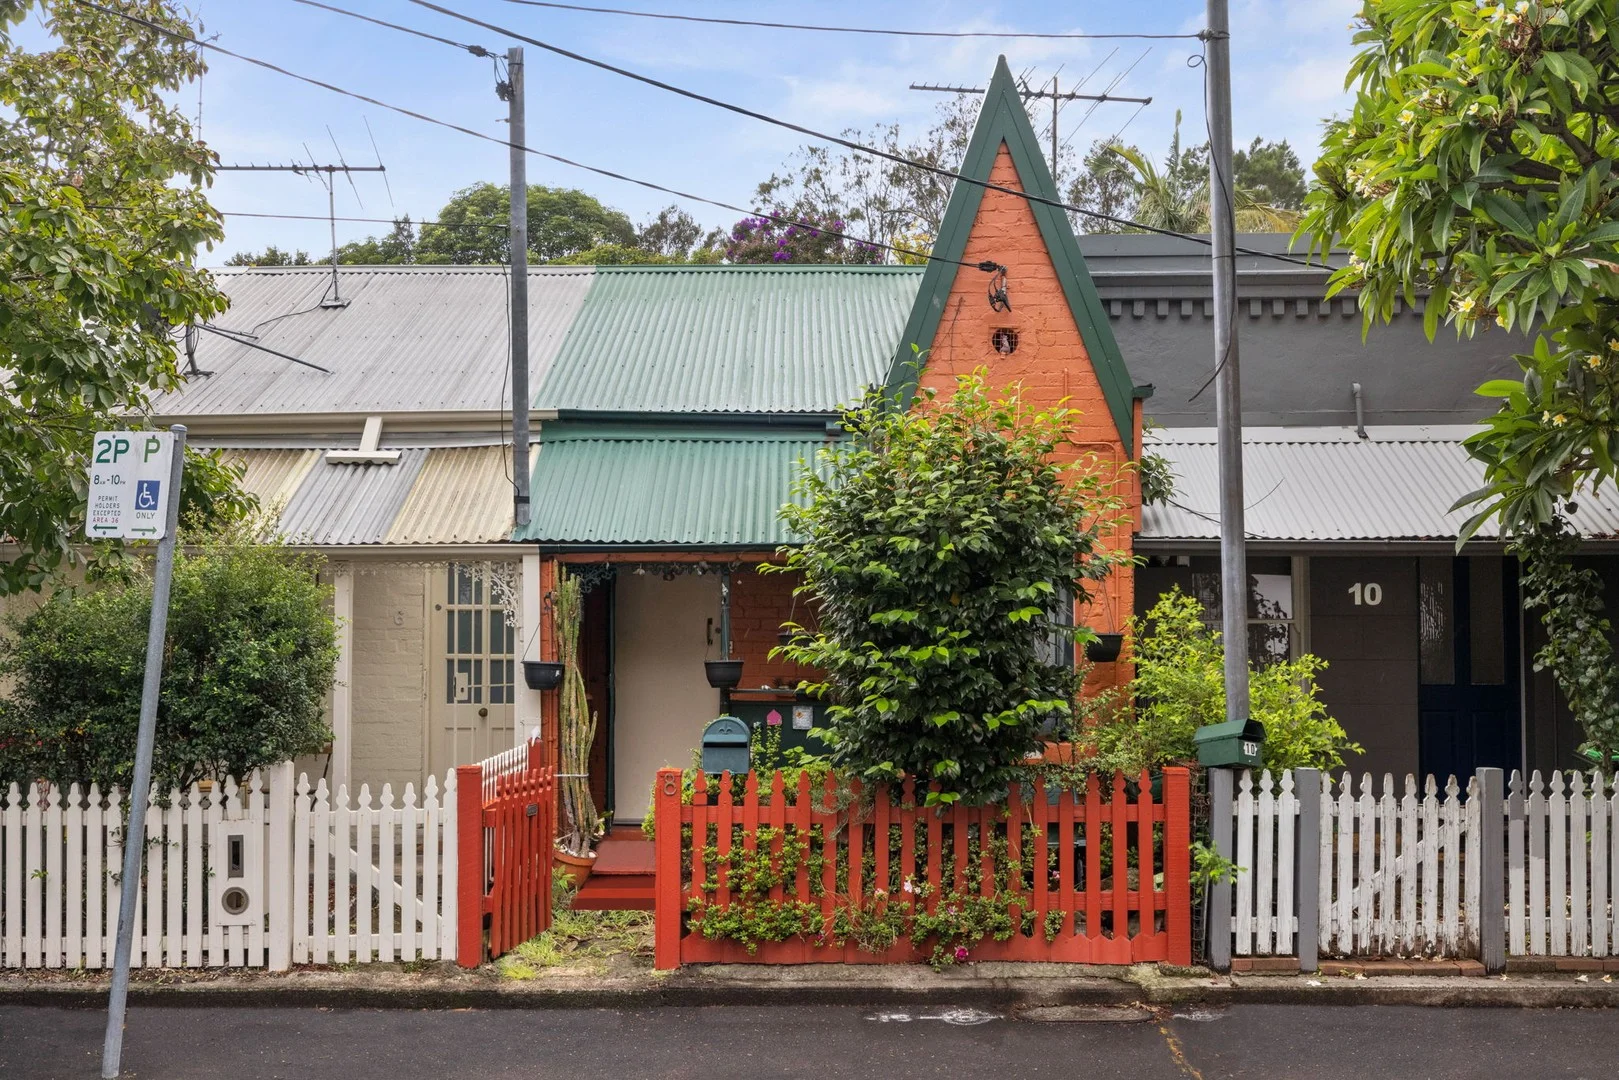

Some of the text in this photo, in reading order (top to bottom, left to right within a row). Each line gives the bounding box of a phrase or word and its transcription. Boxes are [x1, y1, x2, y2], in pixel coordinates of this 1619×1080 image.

[95, 439, 130, 463] 2P
[144, 438, 160, 463] P
[1348, 582, 1382, 606] 10
[1246, 743, 1256, 755] 10
[663, 772, 677, 796] 8
